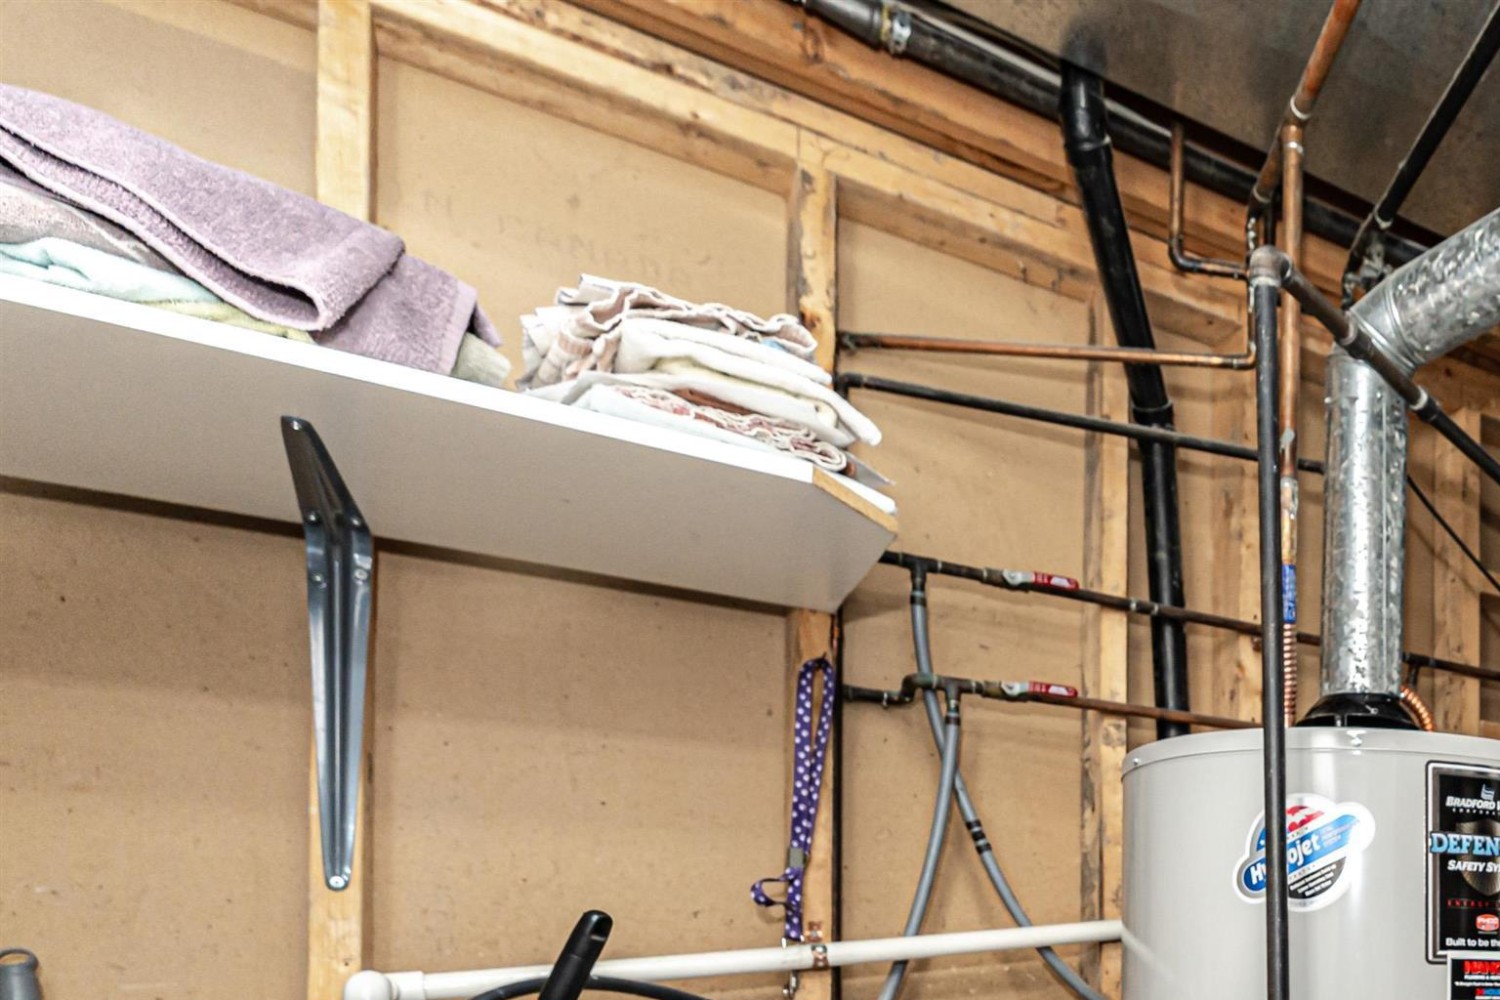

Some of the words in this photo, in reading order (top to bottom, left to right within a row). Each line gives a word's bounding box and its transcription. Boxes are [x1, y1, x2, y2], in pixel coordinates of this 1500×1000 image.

[1445, 796, 1495, 811] BRADFORD
[1447, 859, 1486, 872] SAFETY
[1445, 937, 1466, 947] Built
[1467, 938, 1477, 947] to
[1478, 938, 1489, 947] be
